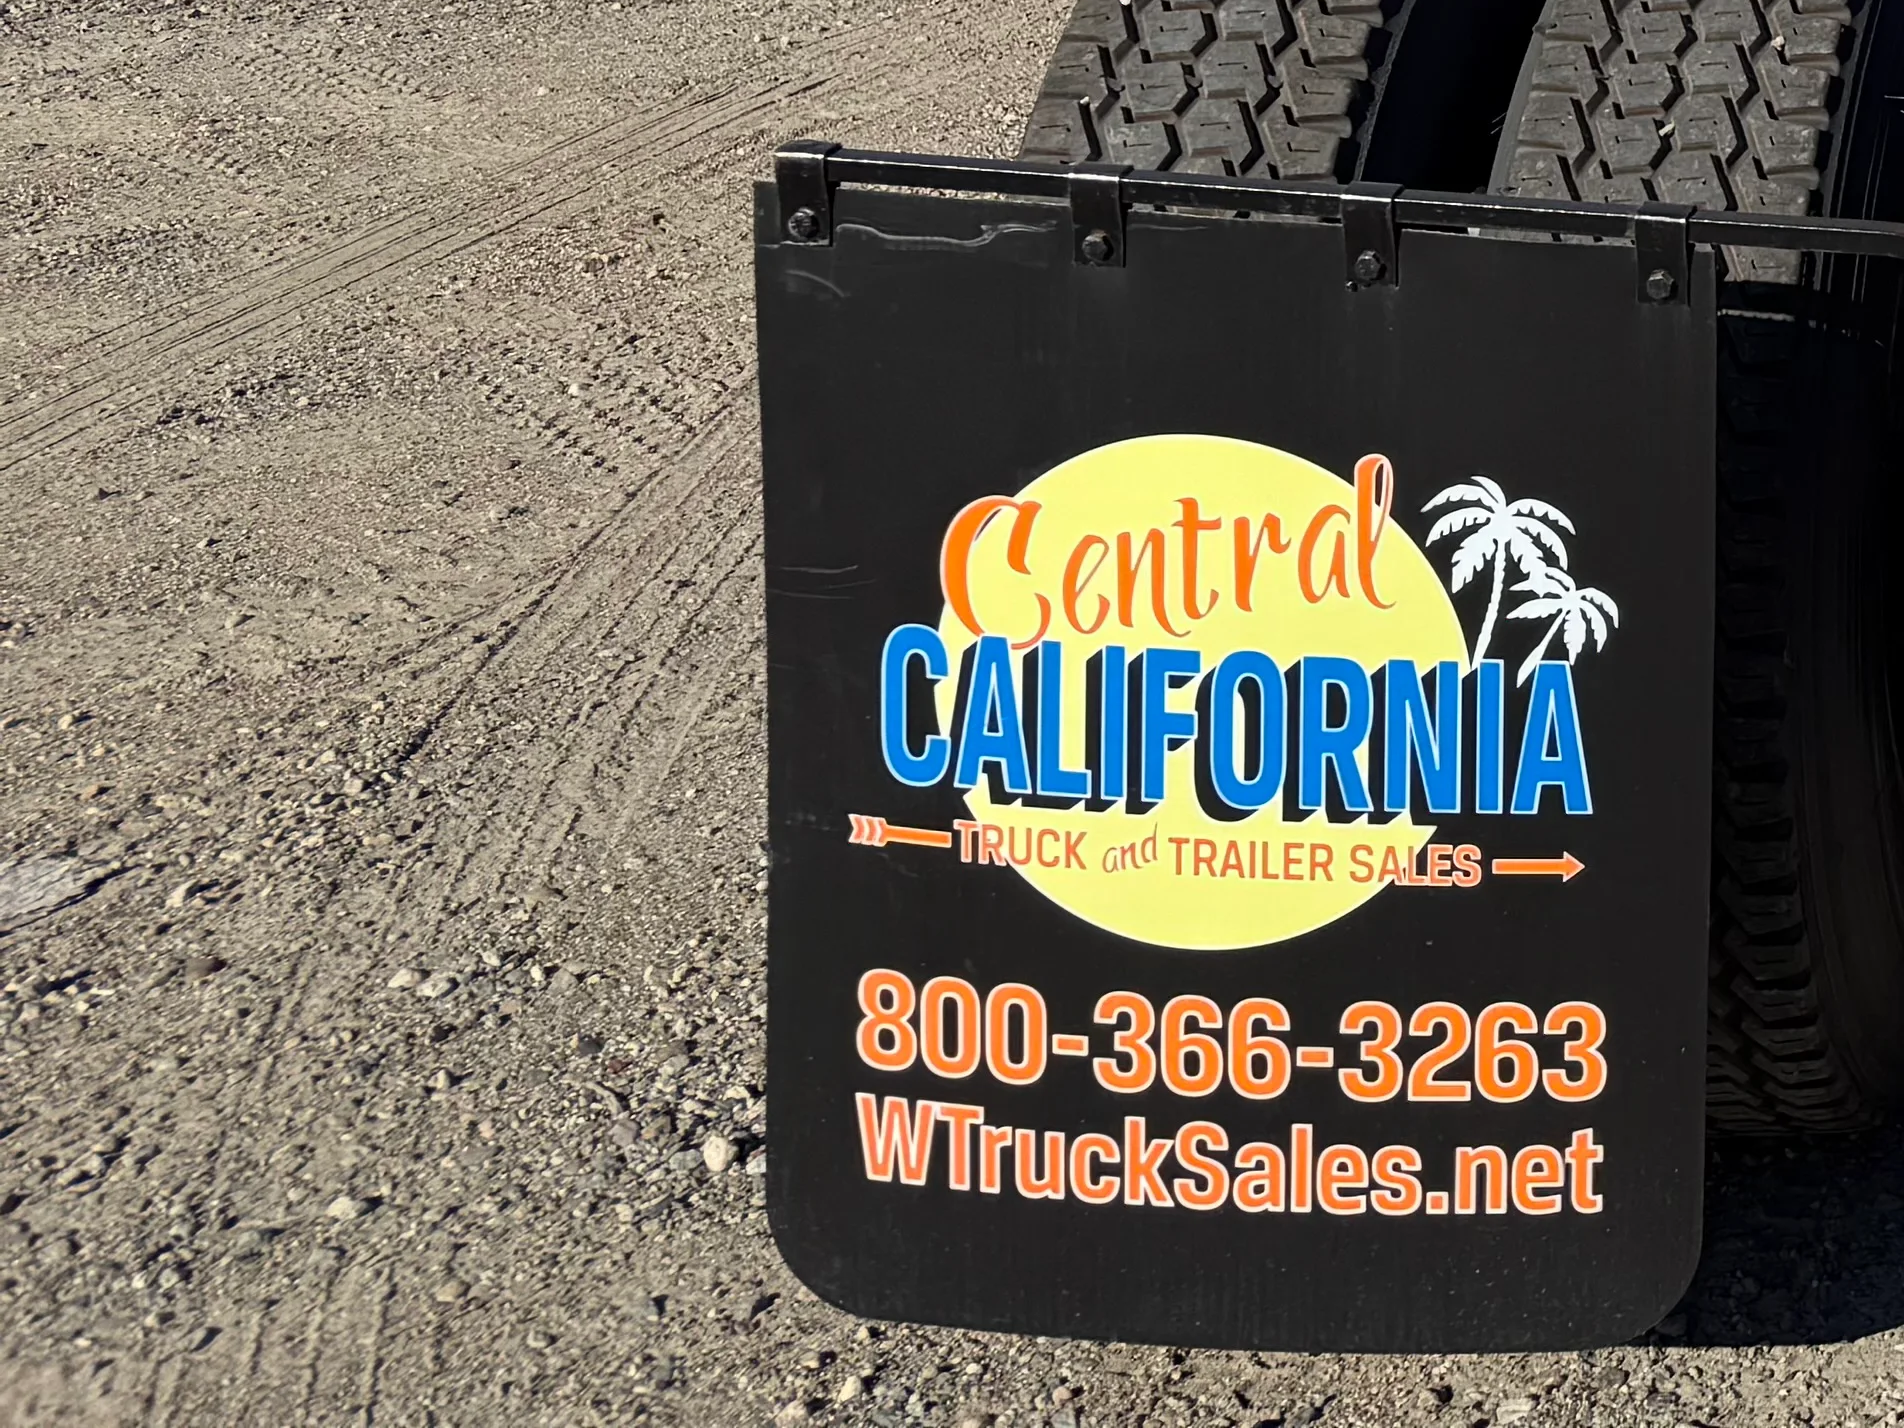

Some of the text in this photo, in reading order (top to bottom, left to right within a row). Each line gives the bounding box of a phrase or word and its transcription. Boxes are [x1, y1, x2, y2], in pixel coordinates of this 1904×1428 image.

[941, 454, 1394, 650] Central
[879, 623, 1594, 816] CALIFORNIA
[954, 819, 1483, 889] TRUCK and TRAILER SALES
[856, 969, 1608, 1103] 800-366-3263
[855, 1093, 1605, 1216] WTruckSales.net
